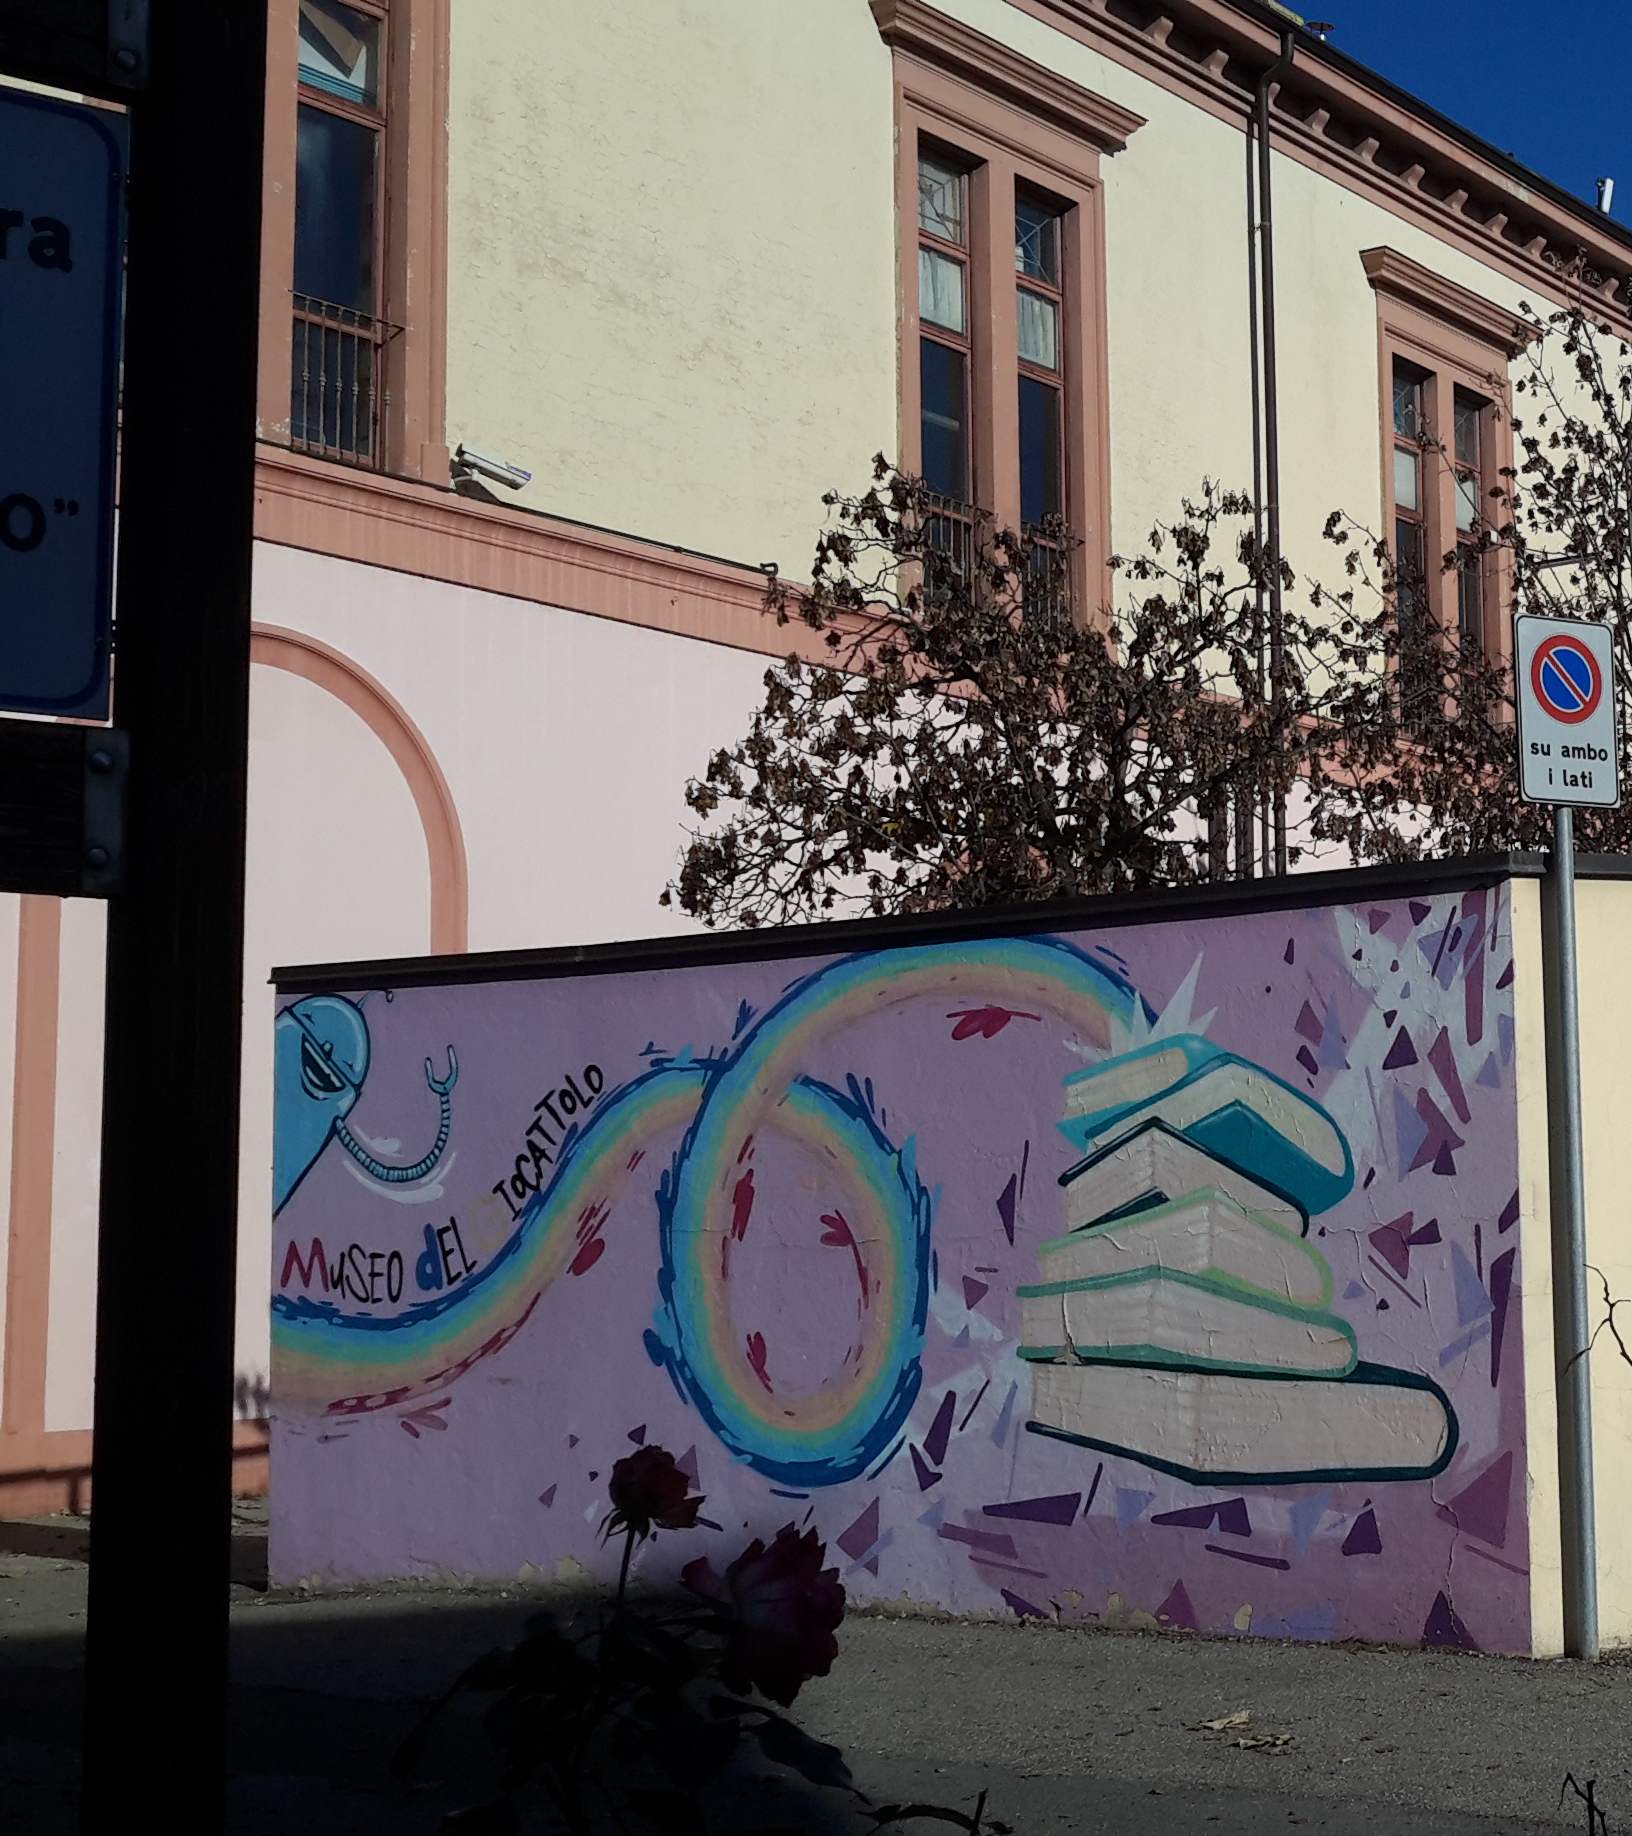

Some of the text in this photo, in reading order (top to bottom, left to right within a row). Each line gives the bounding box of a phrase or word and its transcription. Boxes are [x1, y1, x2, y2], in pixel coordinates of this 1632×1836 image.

[1530, 742, 1608, 761] su ambo
[1548, 768, 1593, 789] i lati
